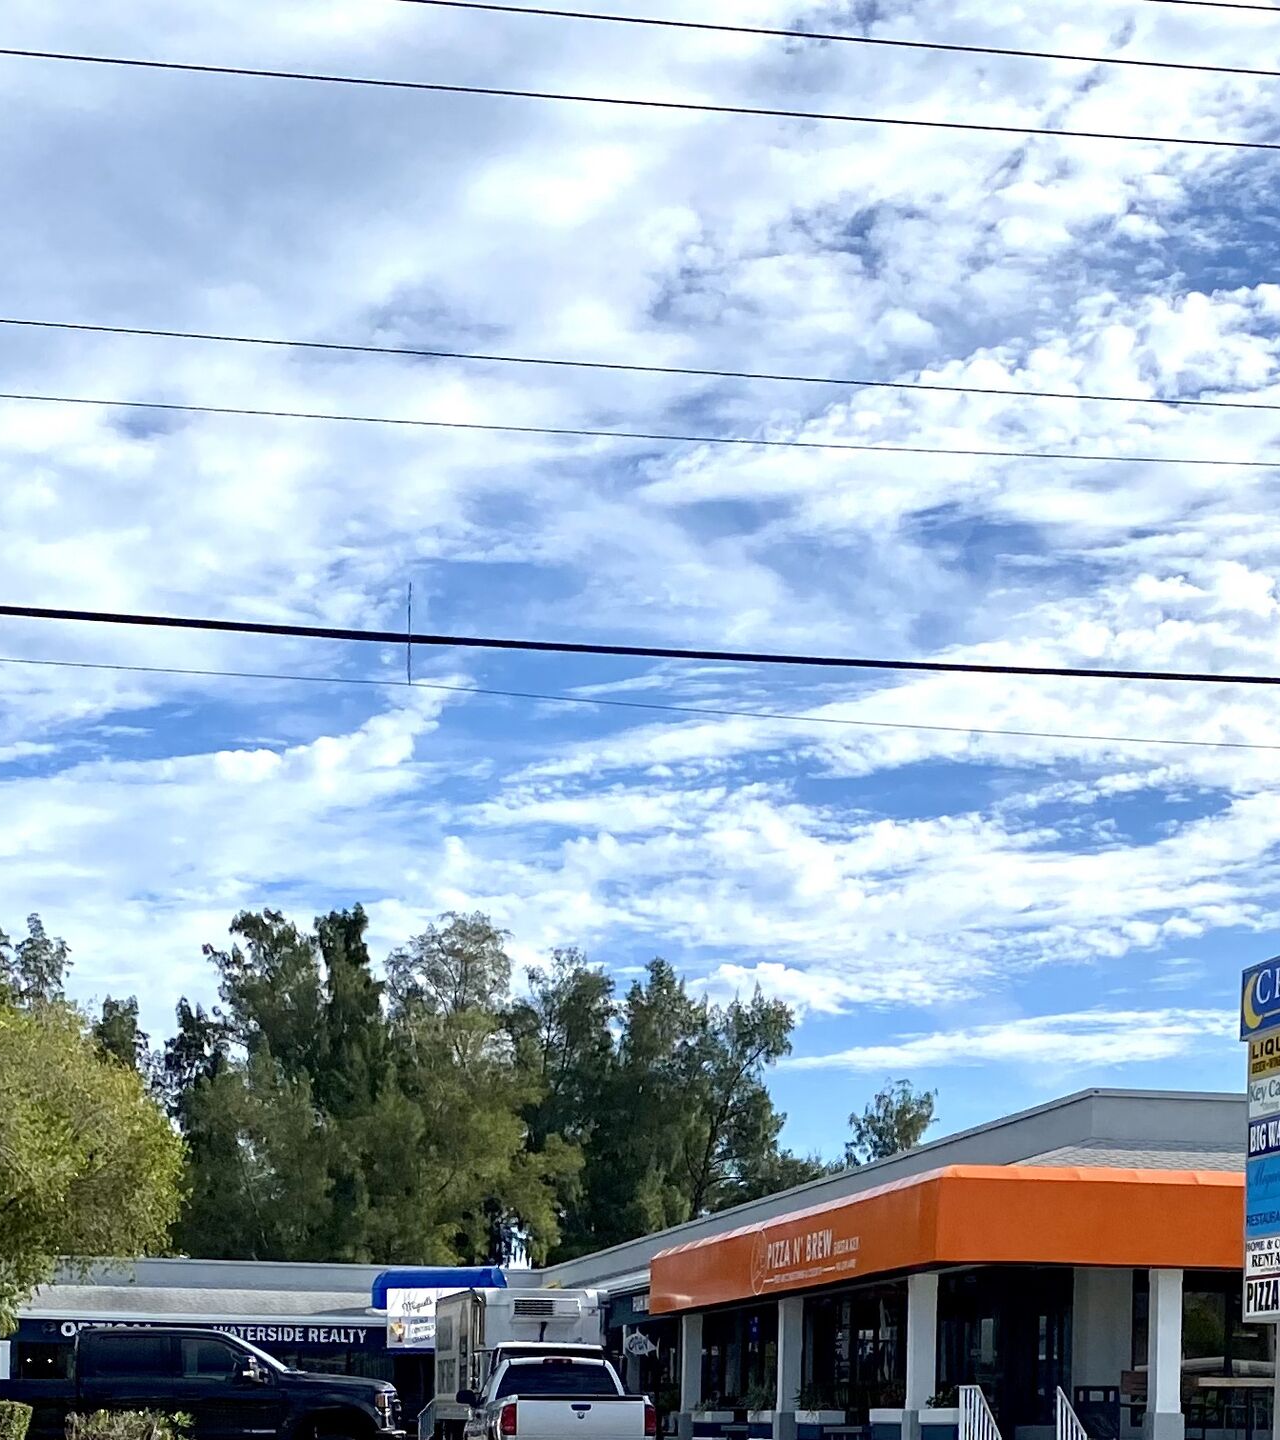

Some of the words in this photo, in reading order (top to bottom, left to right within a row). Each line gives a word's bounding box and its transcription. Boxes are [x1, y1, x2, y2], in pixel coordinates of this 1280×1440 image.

[1249, 1084, 1267, 1107] Key
[1250, 1123, 1267, 1153] BIG
[767, 1239, 791, 1270] PIZZA
[806, 1228, 833, 1262] BREW
[1267, 1240, 1274, 1250] &
[1246, 1280, 1280, 1313] PIZZA
[308, 1328, 367, 1343] REALTY
